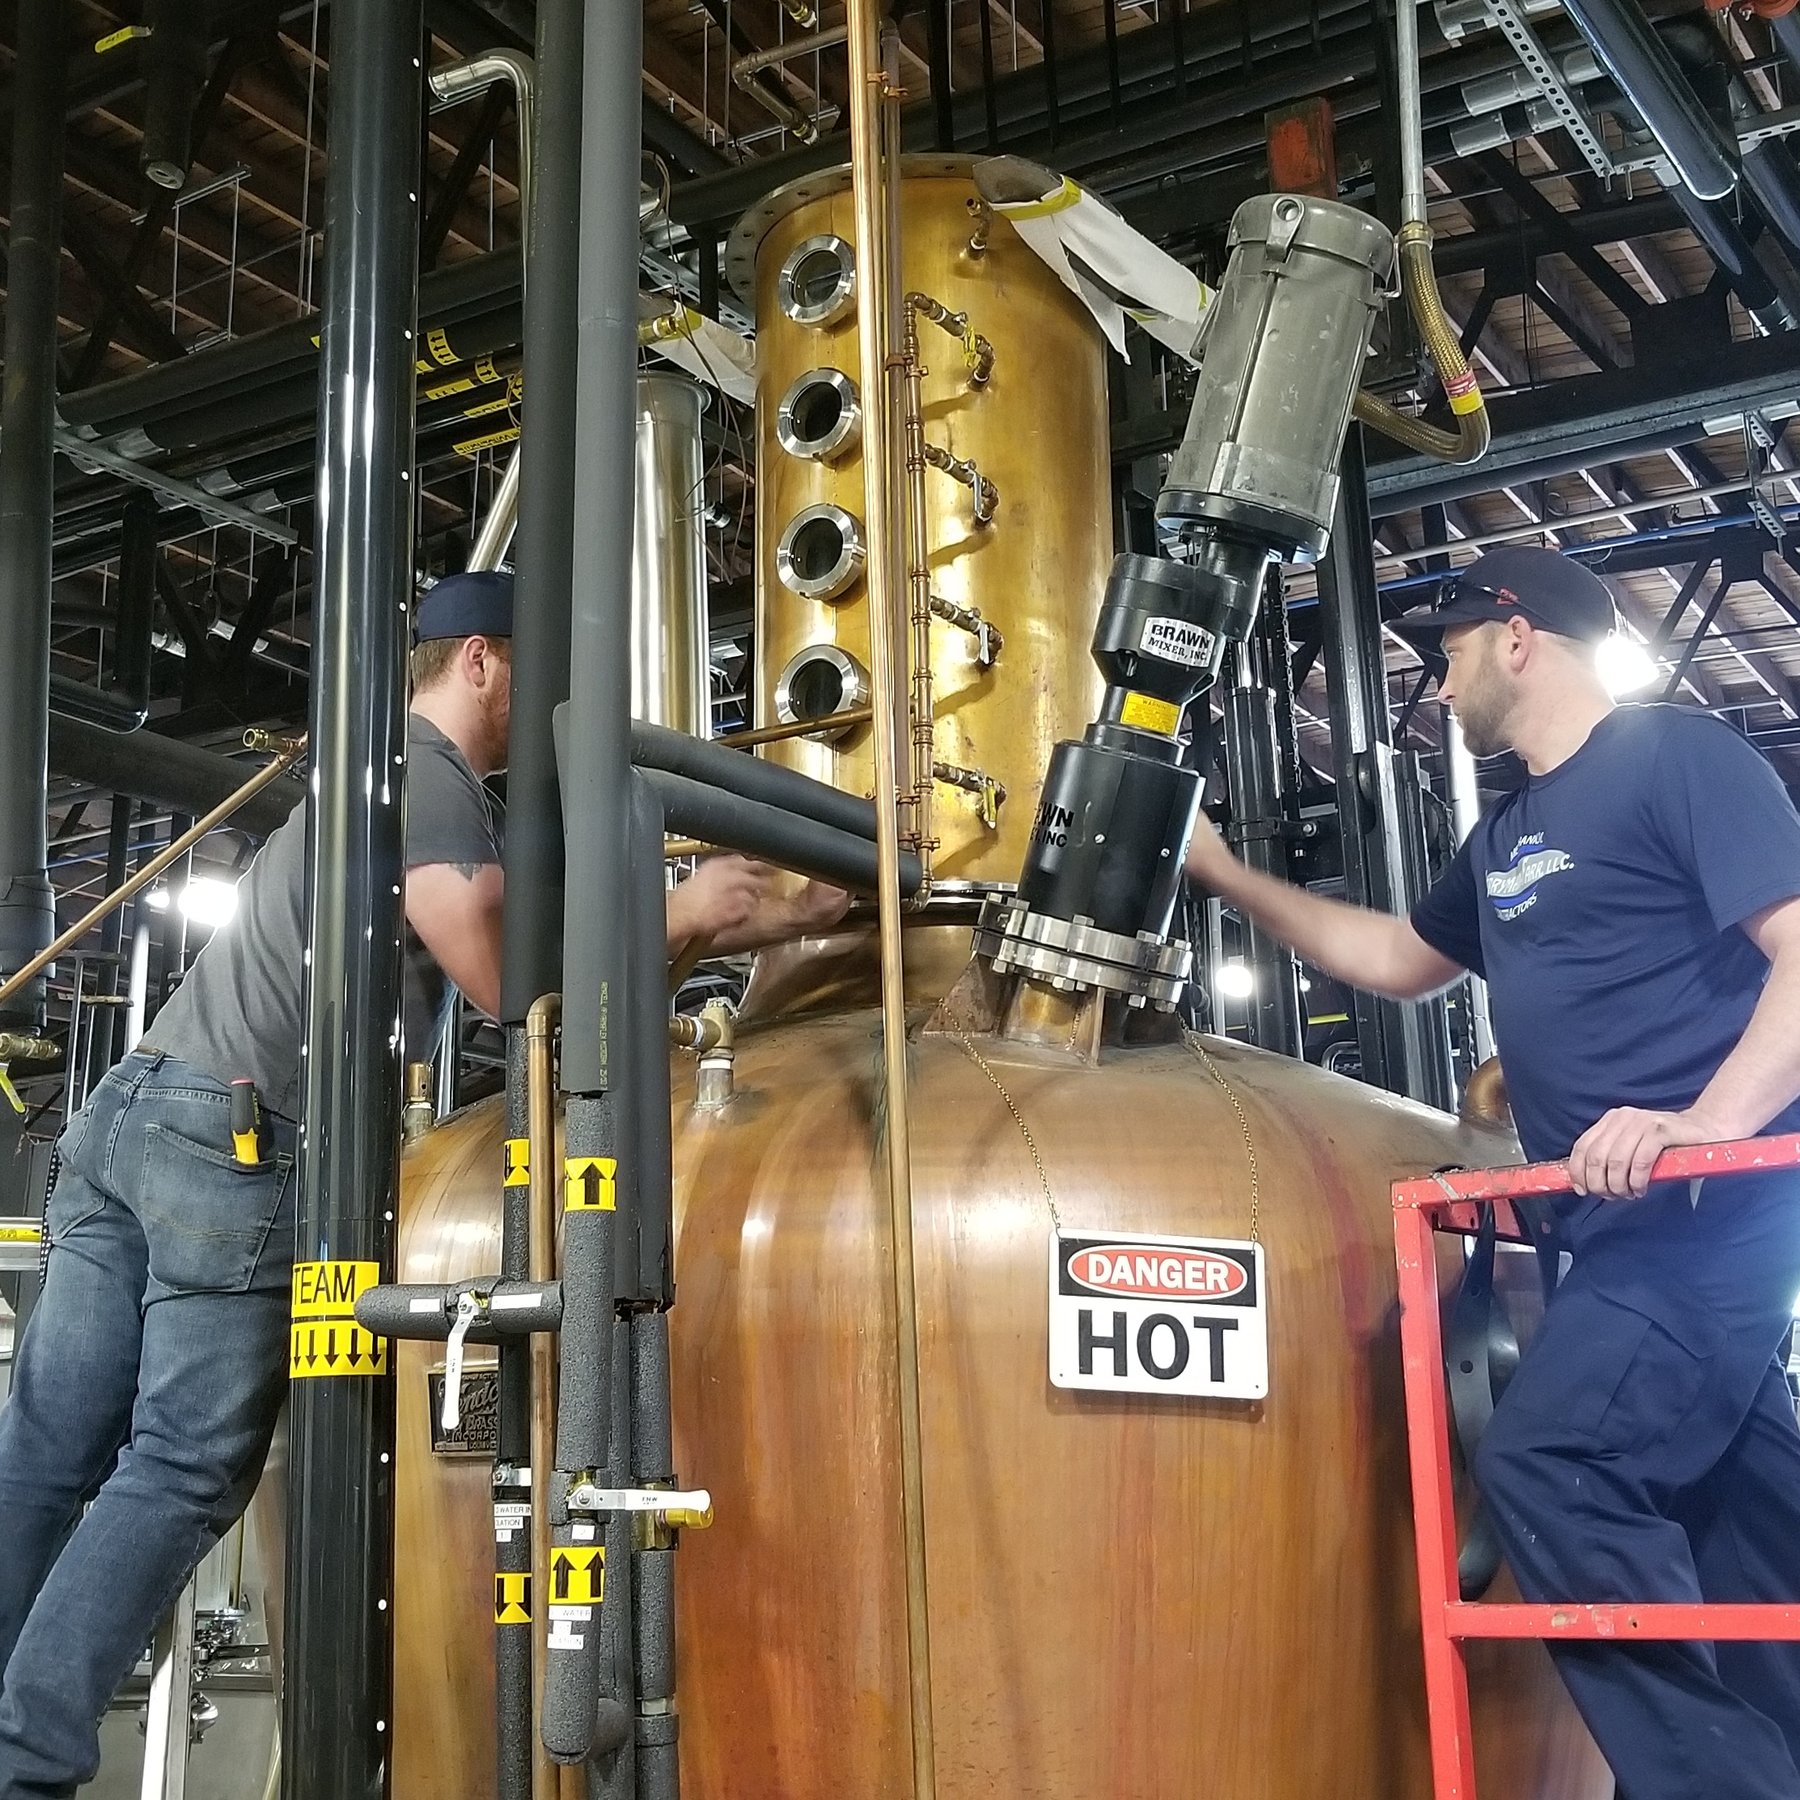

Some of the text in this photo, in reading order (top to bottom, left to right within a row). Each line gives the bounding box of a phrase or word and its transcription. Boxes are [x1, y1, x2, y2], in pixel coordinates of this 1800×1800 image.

[1148, 636, 1188, 659] MIXER,
[1151, 624, 1210, 649] BRAWN
[1087, 1253, 1230, 1292] DANGER
[1078, 1308, 1239, 1383] HOT
[500, 1506, 524, 1514] WATER
